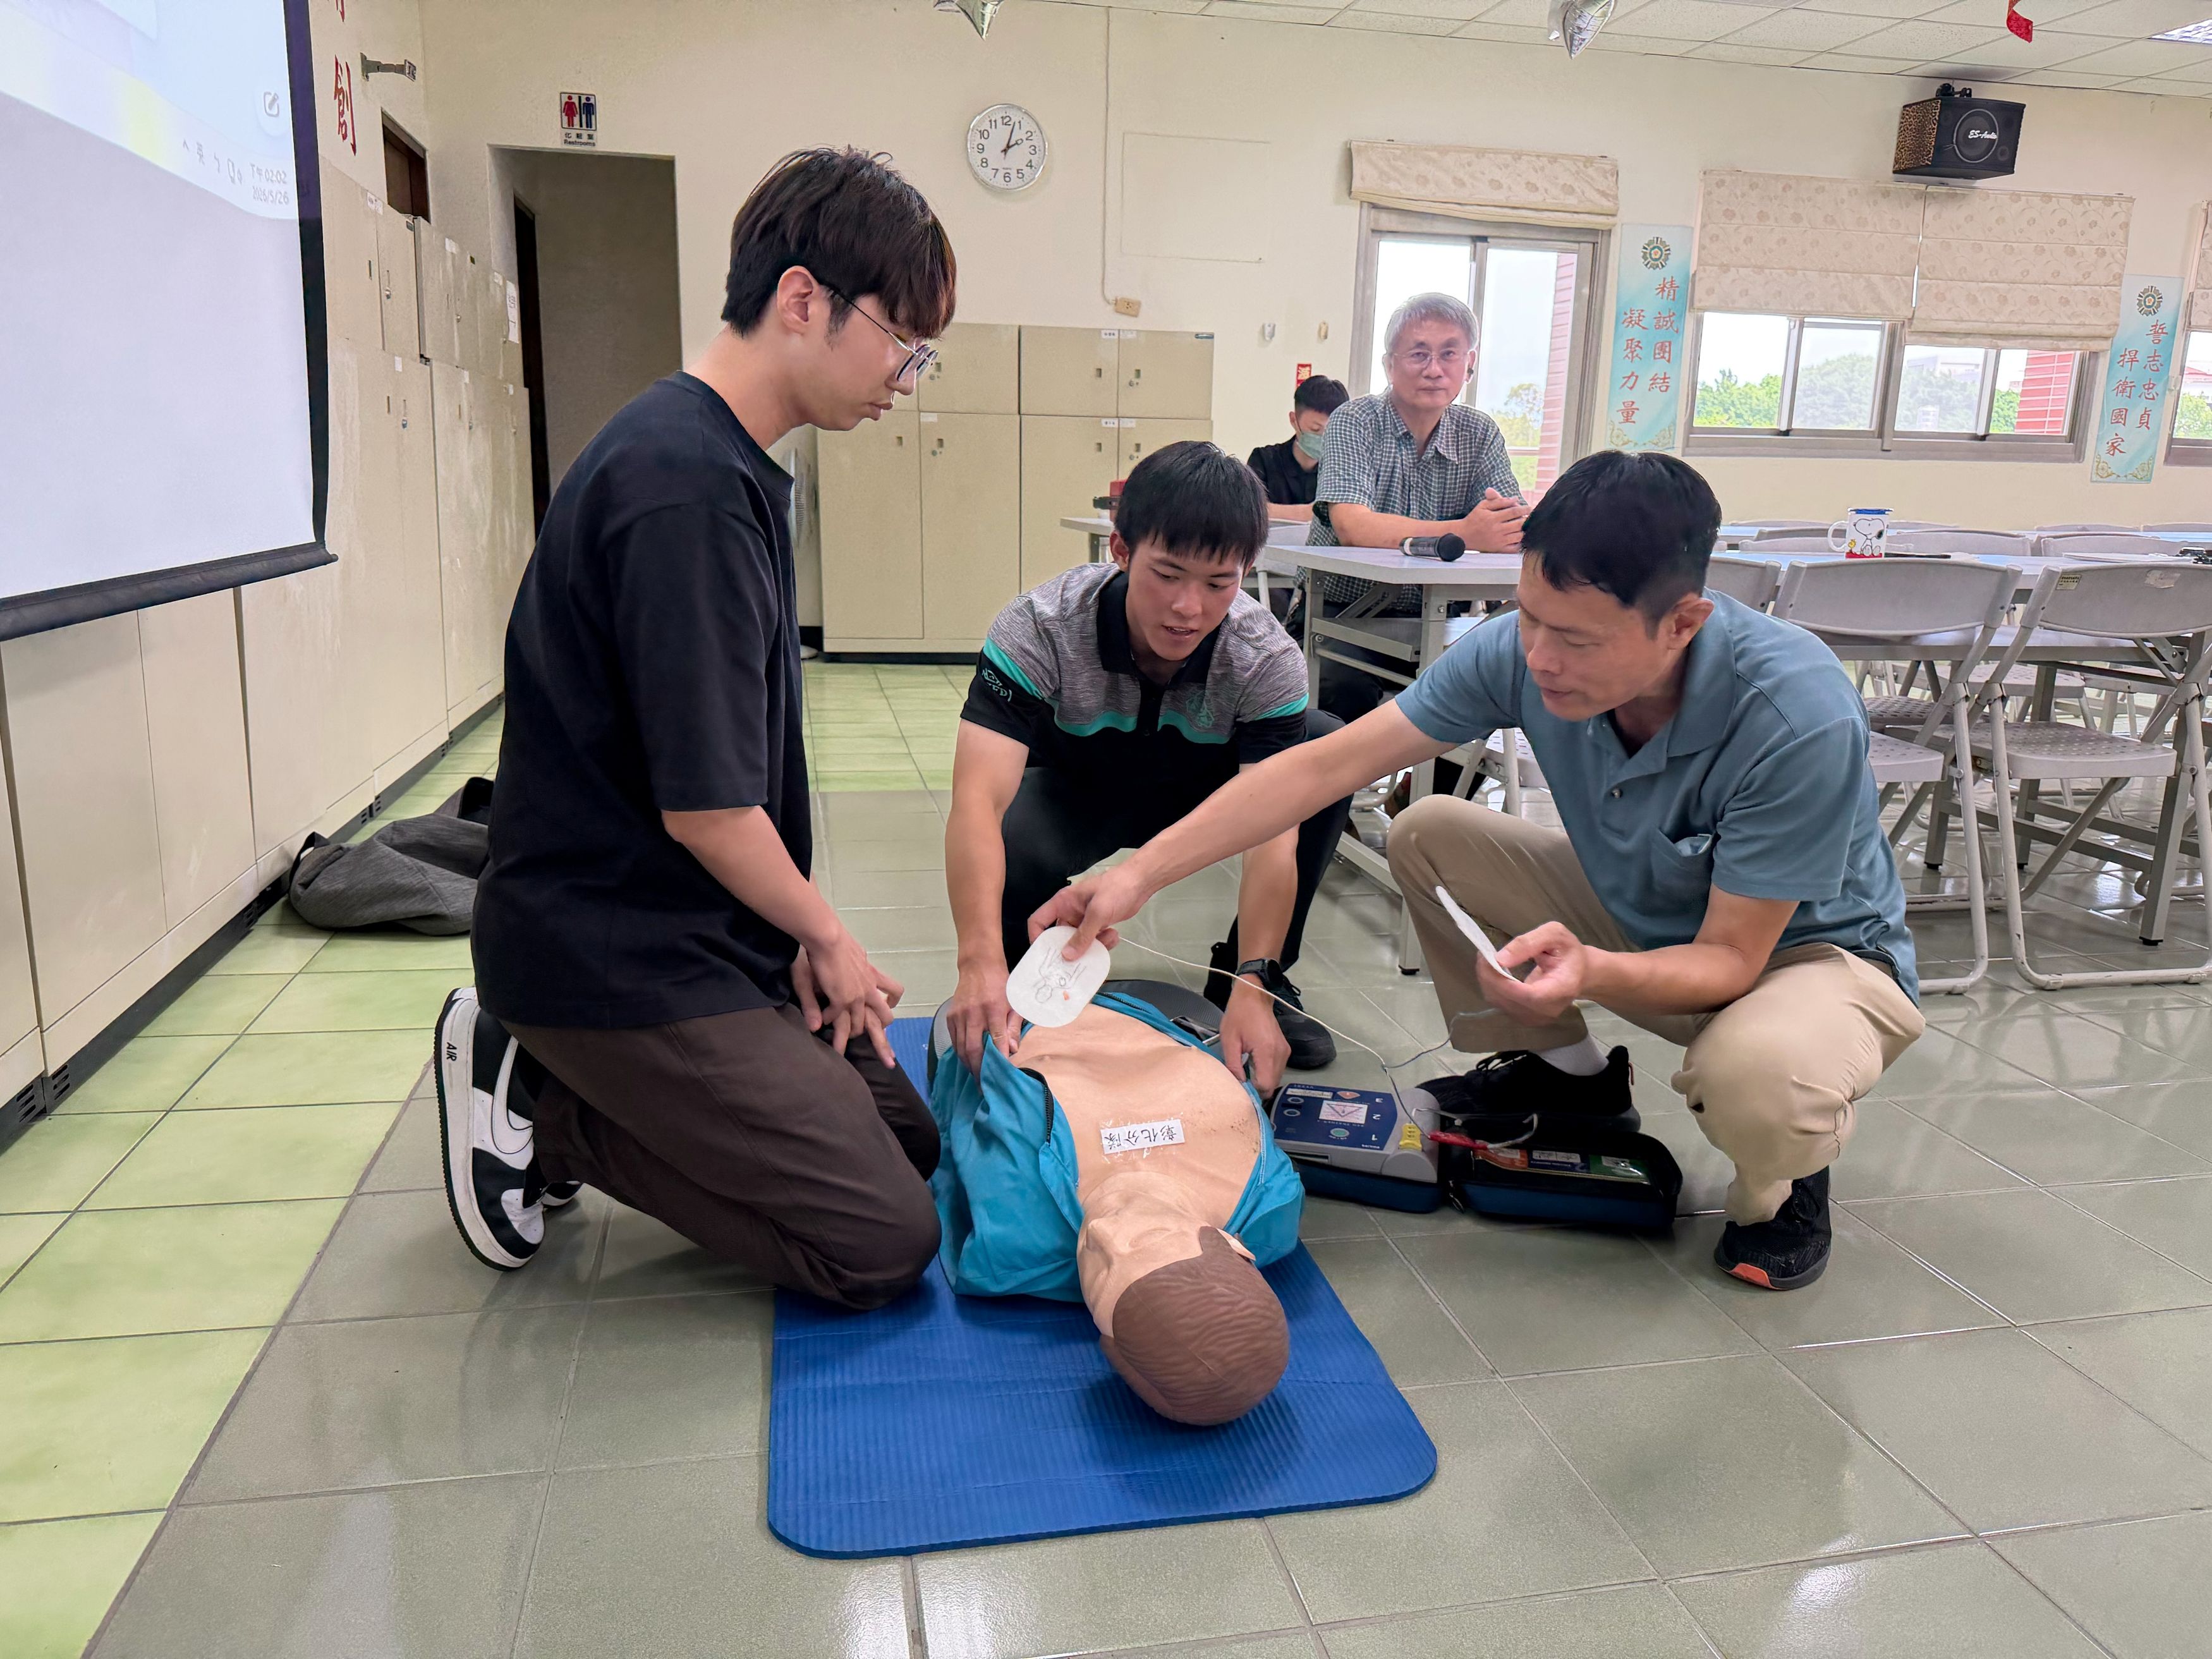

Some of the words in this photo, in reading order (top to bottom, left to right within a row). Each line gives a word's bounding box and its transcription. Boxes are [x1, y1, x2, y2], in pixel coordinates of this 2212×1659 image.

[334, 54, 357, 157] 創
[988, 119, 997, 129] 11
[1000, 115, 1012, 126] 12
[1018, 120, 1022, 130] 1
[979, 129, 990, 140] 10
[1025, 130, 1033, 141] 2
[1968, 130, 1998, 140] ES-Audio
[976, 143, 985, 154] 9
[1029, 145, 1037, 155] 3
[980, 157, 988, 168] 8
[1026, 159, 1034, 169] 4
[991, 168, 999, 178] 7
[1003, 172, 1011, 183] 6
[1016, 169, 1024, 179] 5
[1648, 276, 1679, 393] 精誠團結
[1616, 308, 1648, 425] 凝聚力量
[2136, 319, 2169, 430] 誓志忠貞
[2105, 348, 2139, 456] 捍衛國家
[446, 1042, 457, 1062] AIR
[1104, 1125, 1176, 1150] 彰化分隊
